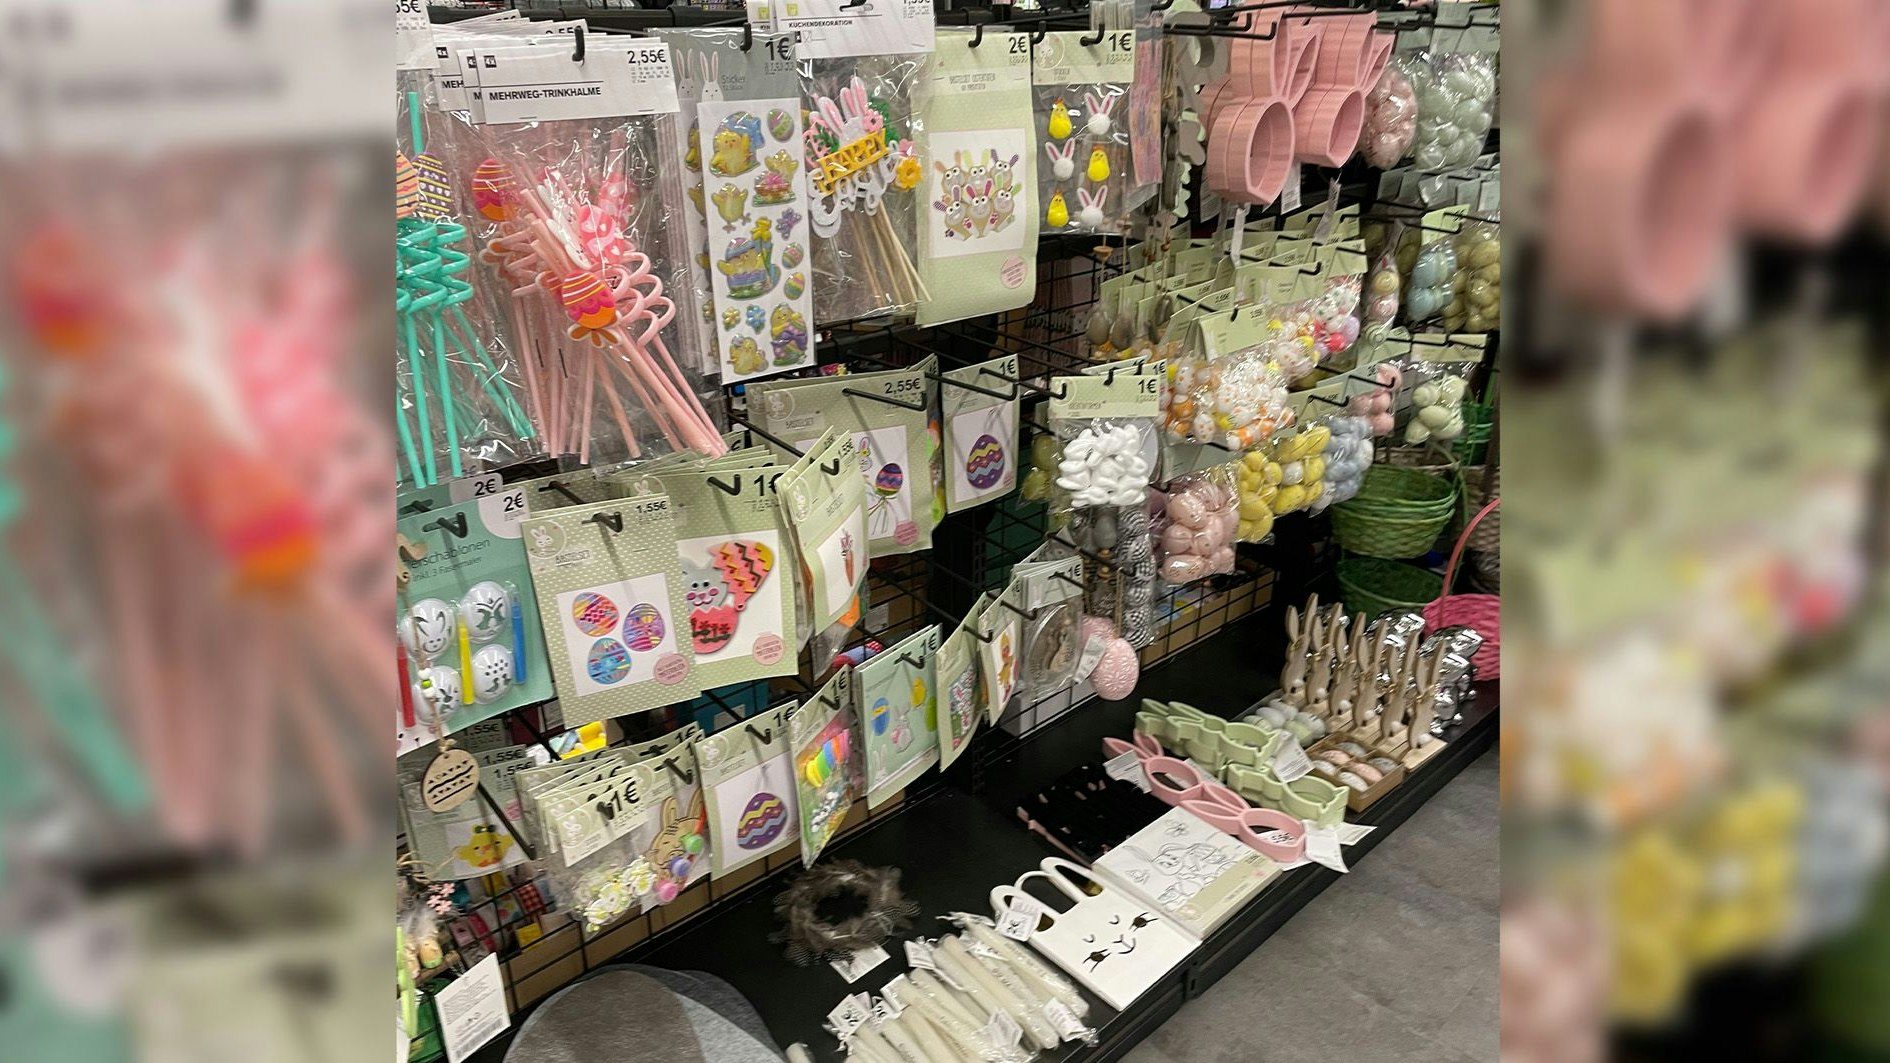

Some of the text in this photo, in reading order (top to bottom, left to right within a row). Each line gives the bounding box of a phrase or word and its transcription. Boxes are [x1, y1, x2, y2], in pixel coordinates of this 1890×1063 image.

[765, 37, 791, 61] 1€
[1008, 36, 1028, 54] 2€
[1108, 33, 1132, 51] 1€
[627, 49, 667, 66] 2,55€
[489, 86, 602, 101] MEHRWEG-TRINKHALME
[1153, 361, 1167, 375] 1€
[1138, 378, 1157, 394] 1€
[475, 478, 496, 496] 2€
[503, 492, 524, 512] 2€
[1067, 563, 1081, 579] 1€
[920, 633, 937, 656] 1€
[832, 671, 847, 696] 1€
[611, 780, 640, 812] 1€
